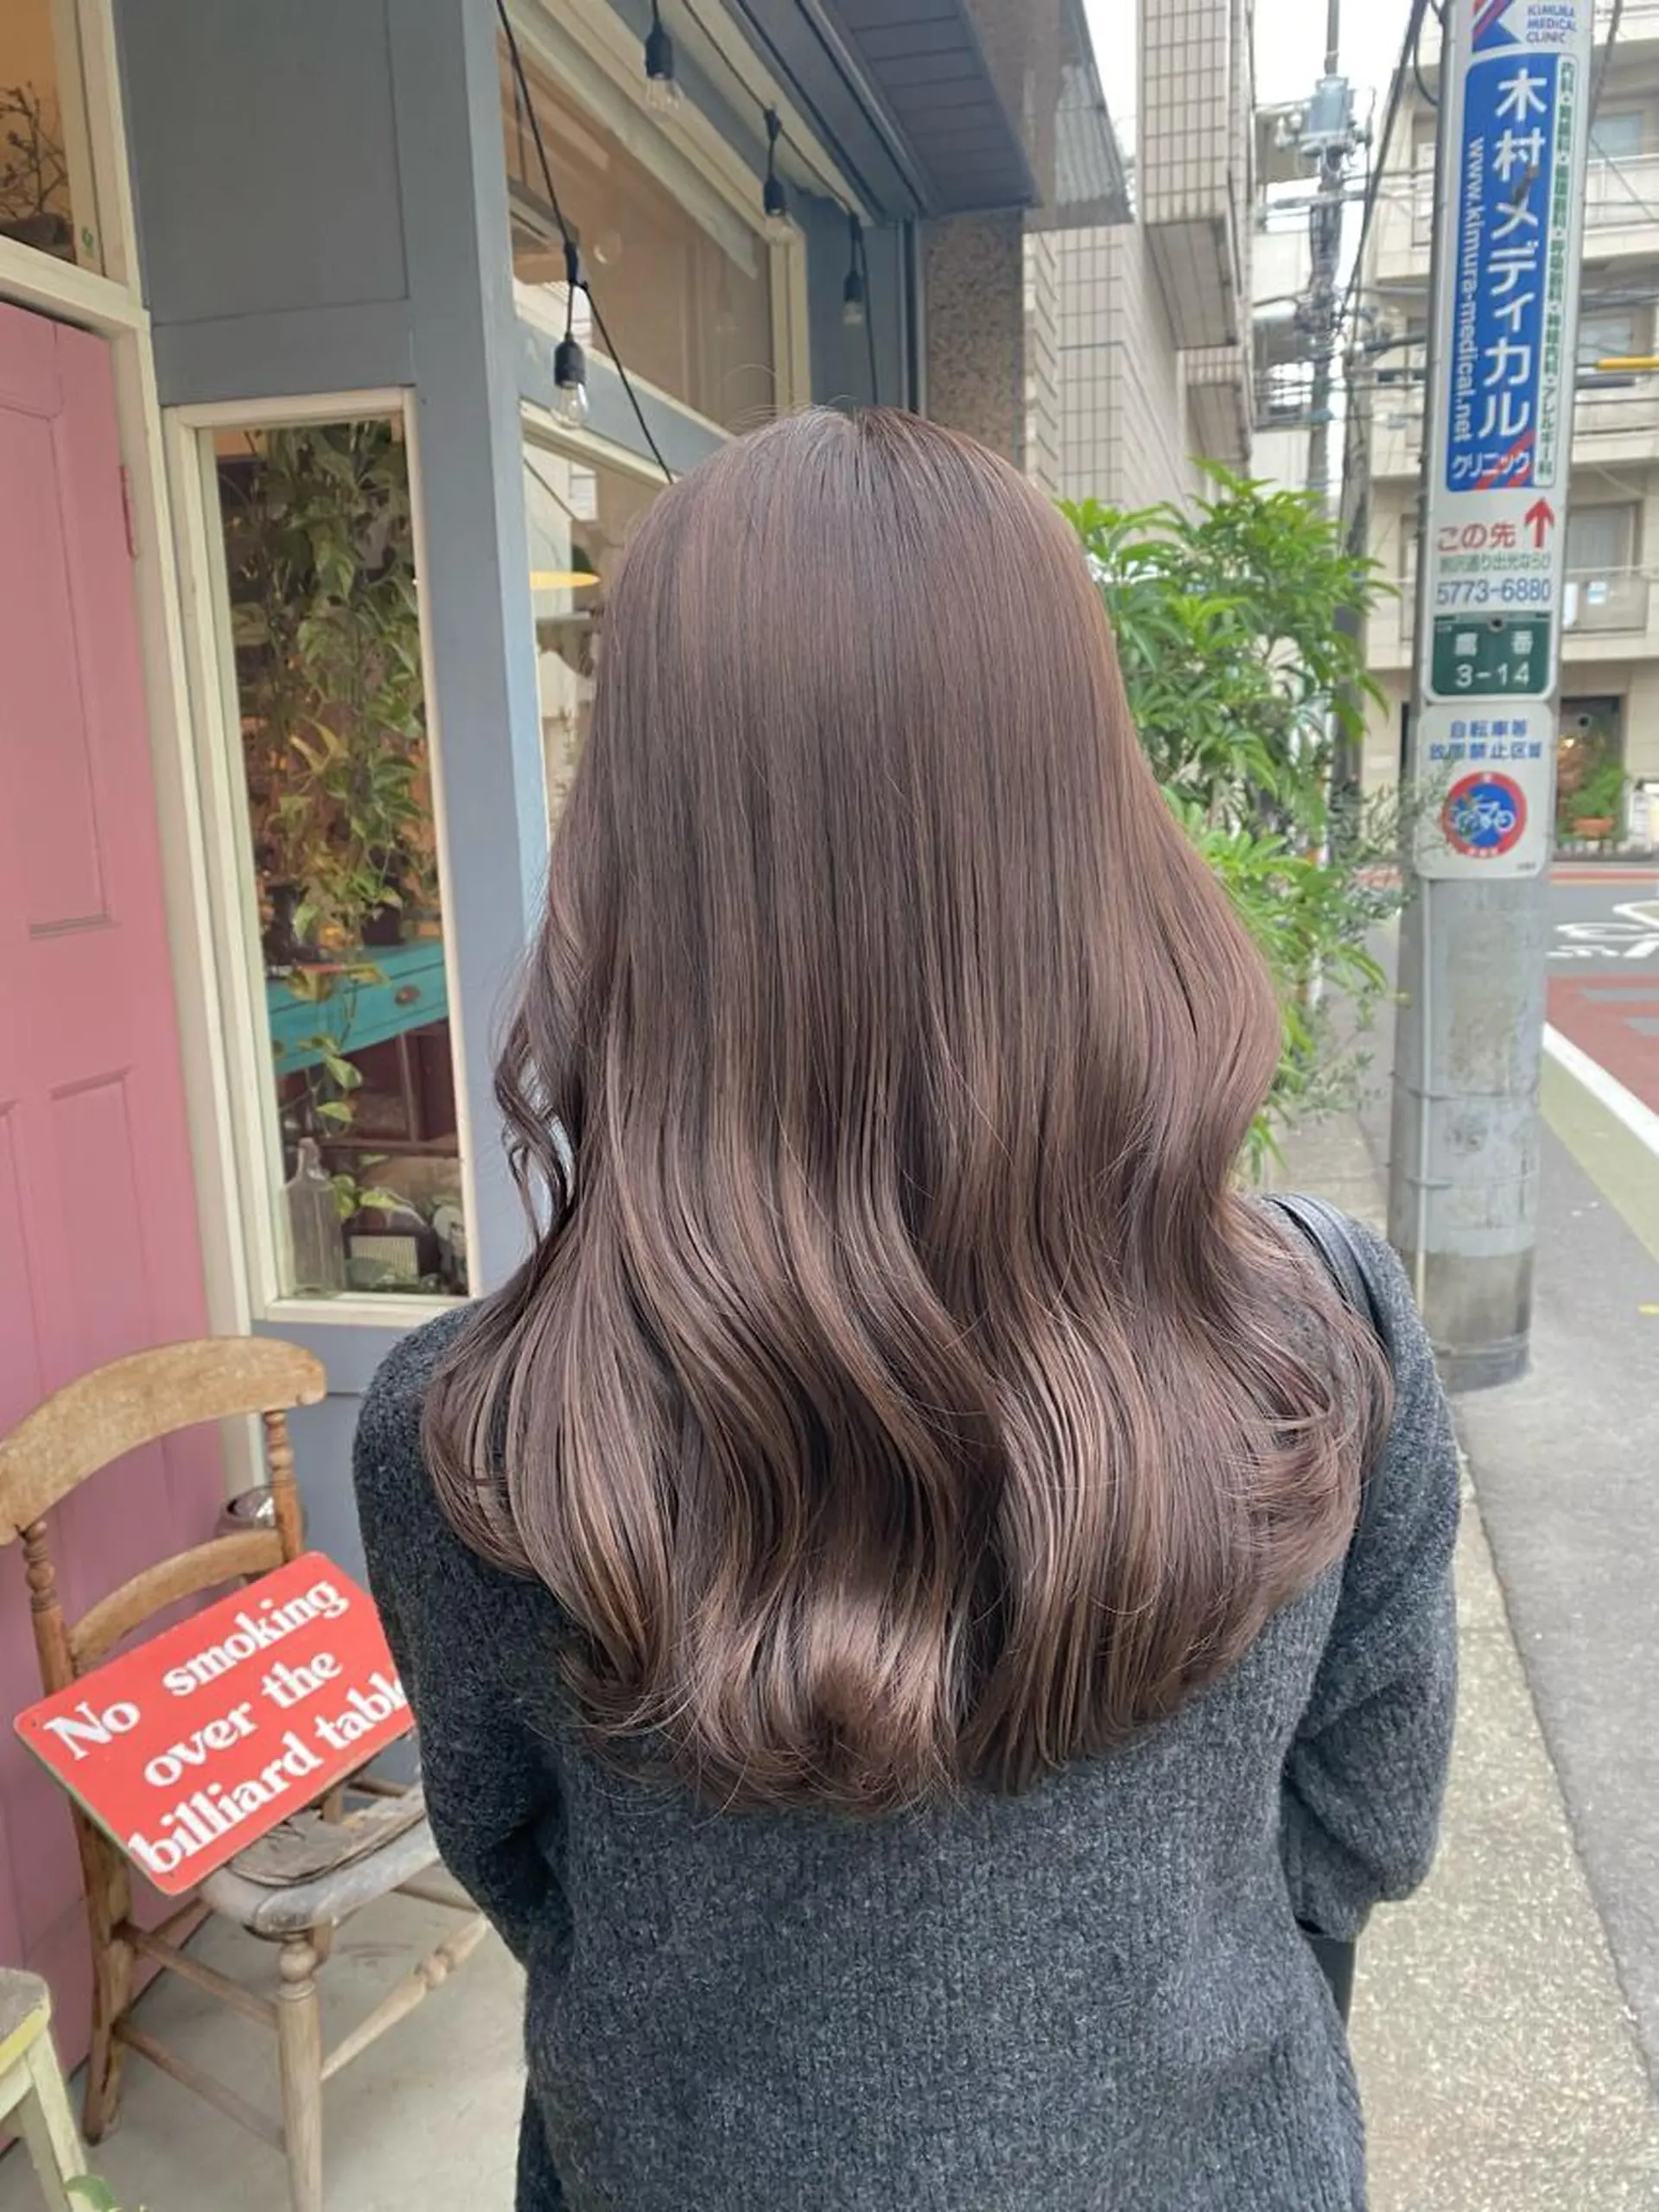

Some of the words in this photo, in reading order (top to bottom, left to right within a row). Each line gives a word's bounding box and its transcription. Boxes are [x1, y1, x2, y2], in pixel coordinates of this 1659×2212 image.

[1526, 31, 1567, 44] CLINIC
[1527, 17, 1577, 31] MEDICAL
[1478, 67, 1548, 440] 木村メディカル
[1453, 137, 1486, 443] www.kimura-medical.net
[1452, 451, 1530, 480] クリニック
[1436, 521, 1516, 551] この先
[1435, 578, 1552, 605] 5773-6880
[1455, 661, 1530, 688] 3-14
[43, 1700, 141, 1760] No
[162, 1580, 350, 1696] smoking
[143, 1701, 258, 1788] over
[261, 1651, 343, 1708] the
[127, 1731, 324, 1873] billiard
